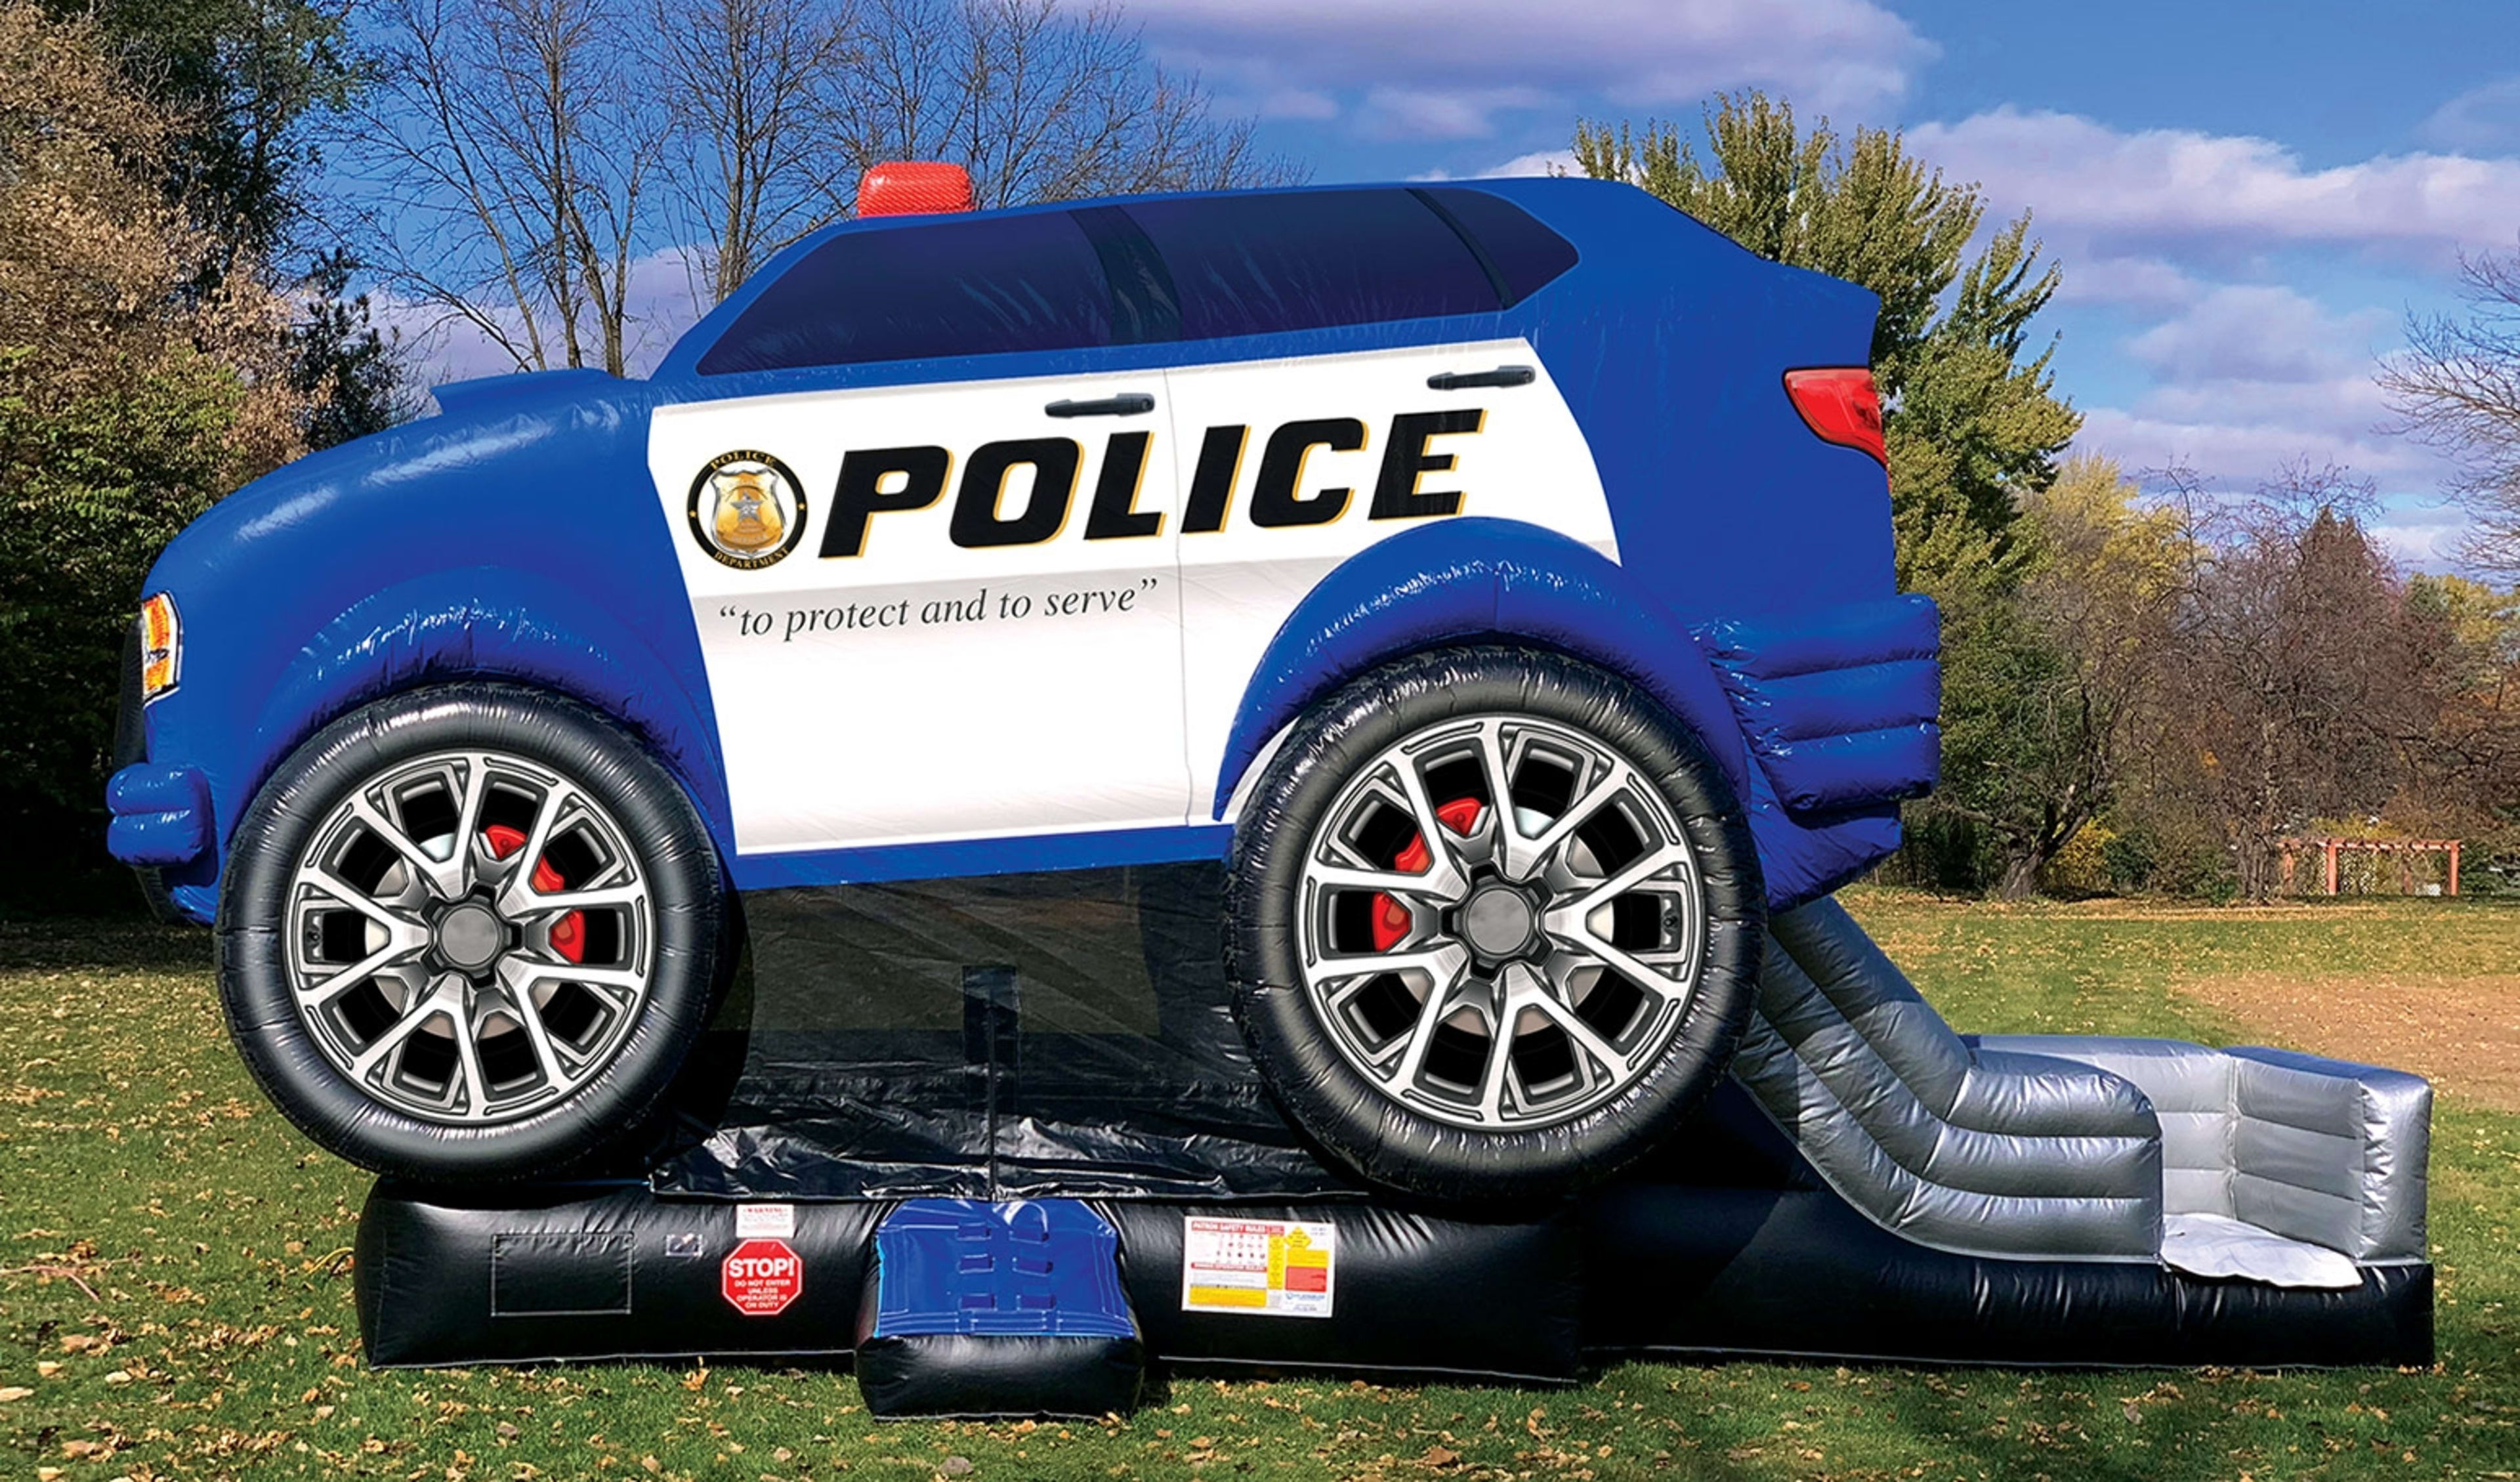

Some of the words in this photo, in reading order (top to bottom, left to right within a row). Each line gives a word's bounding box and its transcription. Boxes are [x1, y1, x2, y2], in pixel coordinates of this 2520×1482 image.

[710, 451, 776, 469] POLICE
[818, 408, 1488, 561] POLICE
[714, 546, 788, 569] DEPARTMENT
[720, 606, 773, 636] “to
[783, 600, 909, 643] protect
[921, 588, 987, 624] and
[998, 593, 1032, 619] to
[1044, 578, 1158, 616] serve”
[728, 1258, 794, 1277] STOP!
